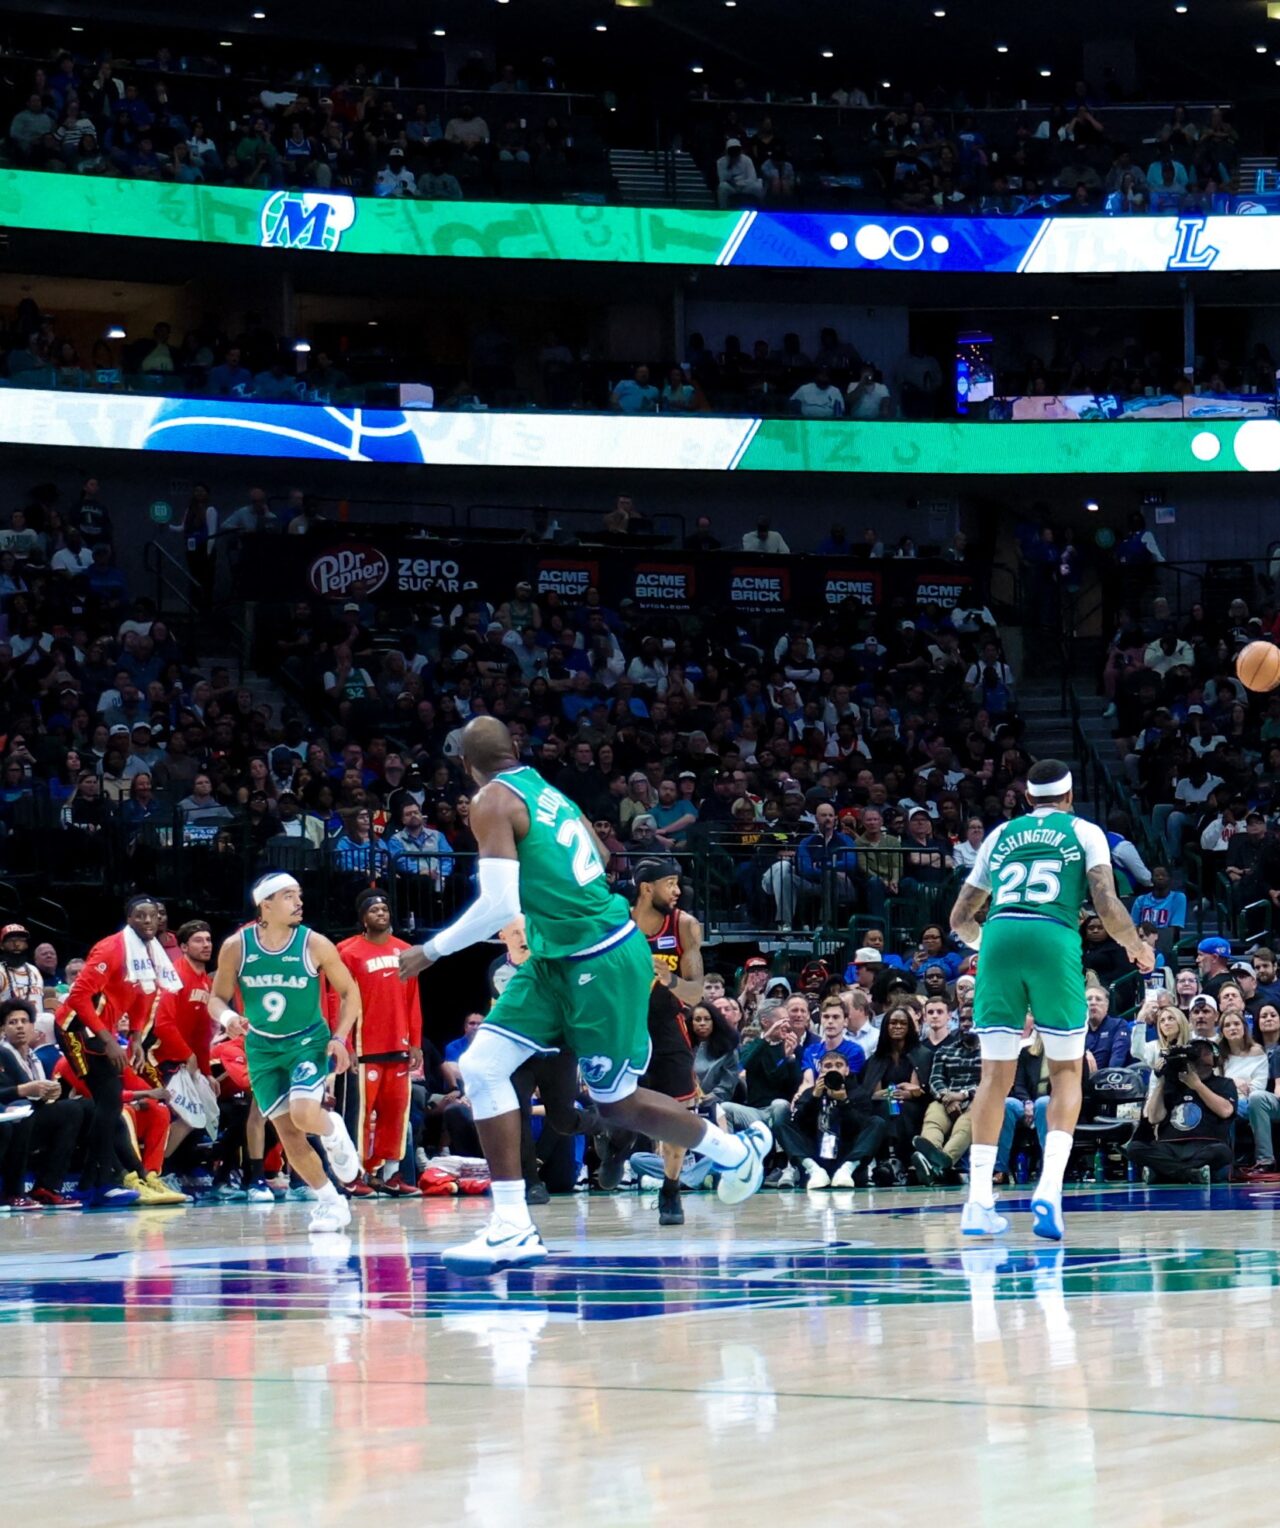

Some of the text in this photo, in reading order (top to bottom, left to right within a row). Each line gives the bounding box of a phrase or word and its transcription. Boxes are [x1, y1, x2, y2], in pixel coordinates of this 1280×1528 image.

[338, 551, 366, 573] Dr
[398, 558, 460, 579] zero
[317, 555, 384, 595] Pepper
[538, 570, 590, 583] ACME
[635, 573, 686, 587] ACME
[398, 577, 460, 593] SUGAR
[538, 583, 588, 596] BRICK
[731, 577, 781, 590] ACME
[825, 580, 873, 593] ACME
[916, 585, 963, 597] ACME
[635, 586, 686, 599] BRICK
[731, 590, 781, 602] BRICK
[990, 828, 1081, 872] WASHINGTON JR.
[995, 859, 1063, 906] 25
[242, 973, 309, 989] DALLAS
[262, 990, 287, 1022] 9
